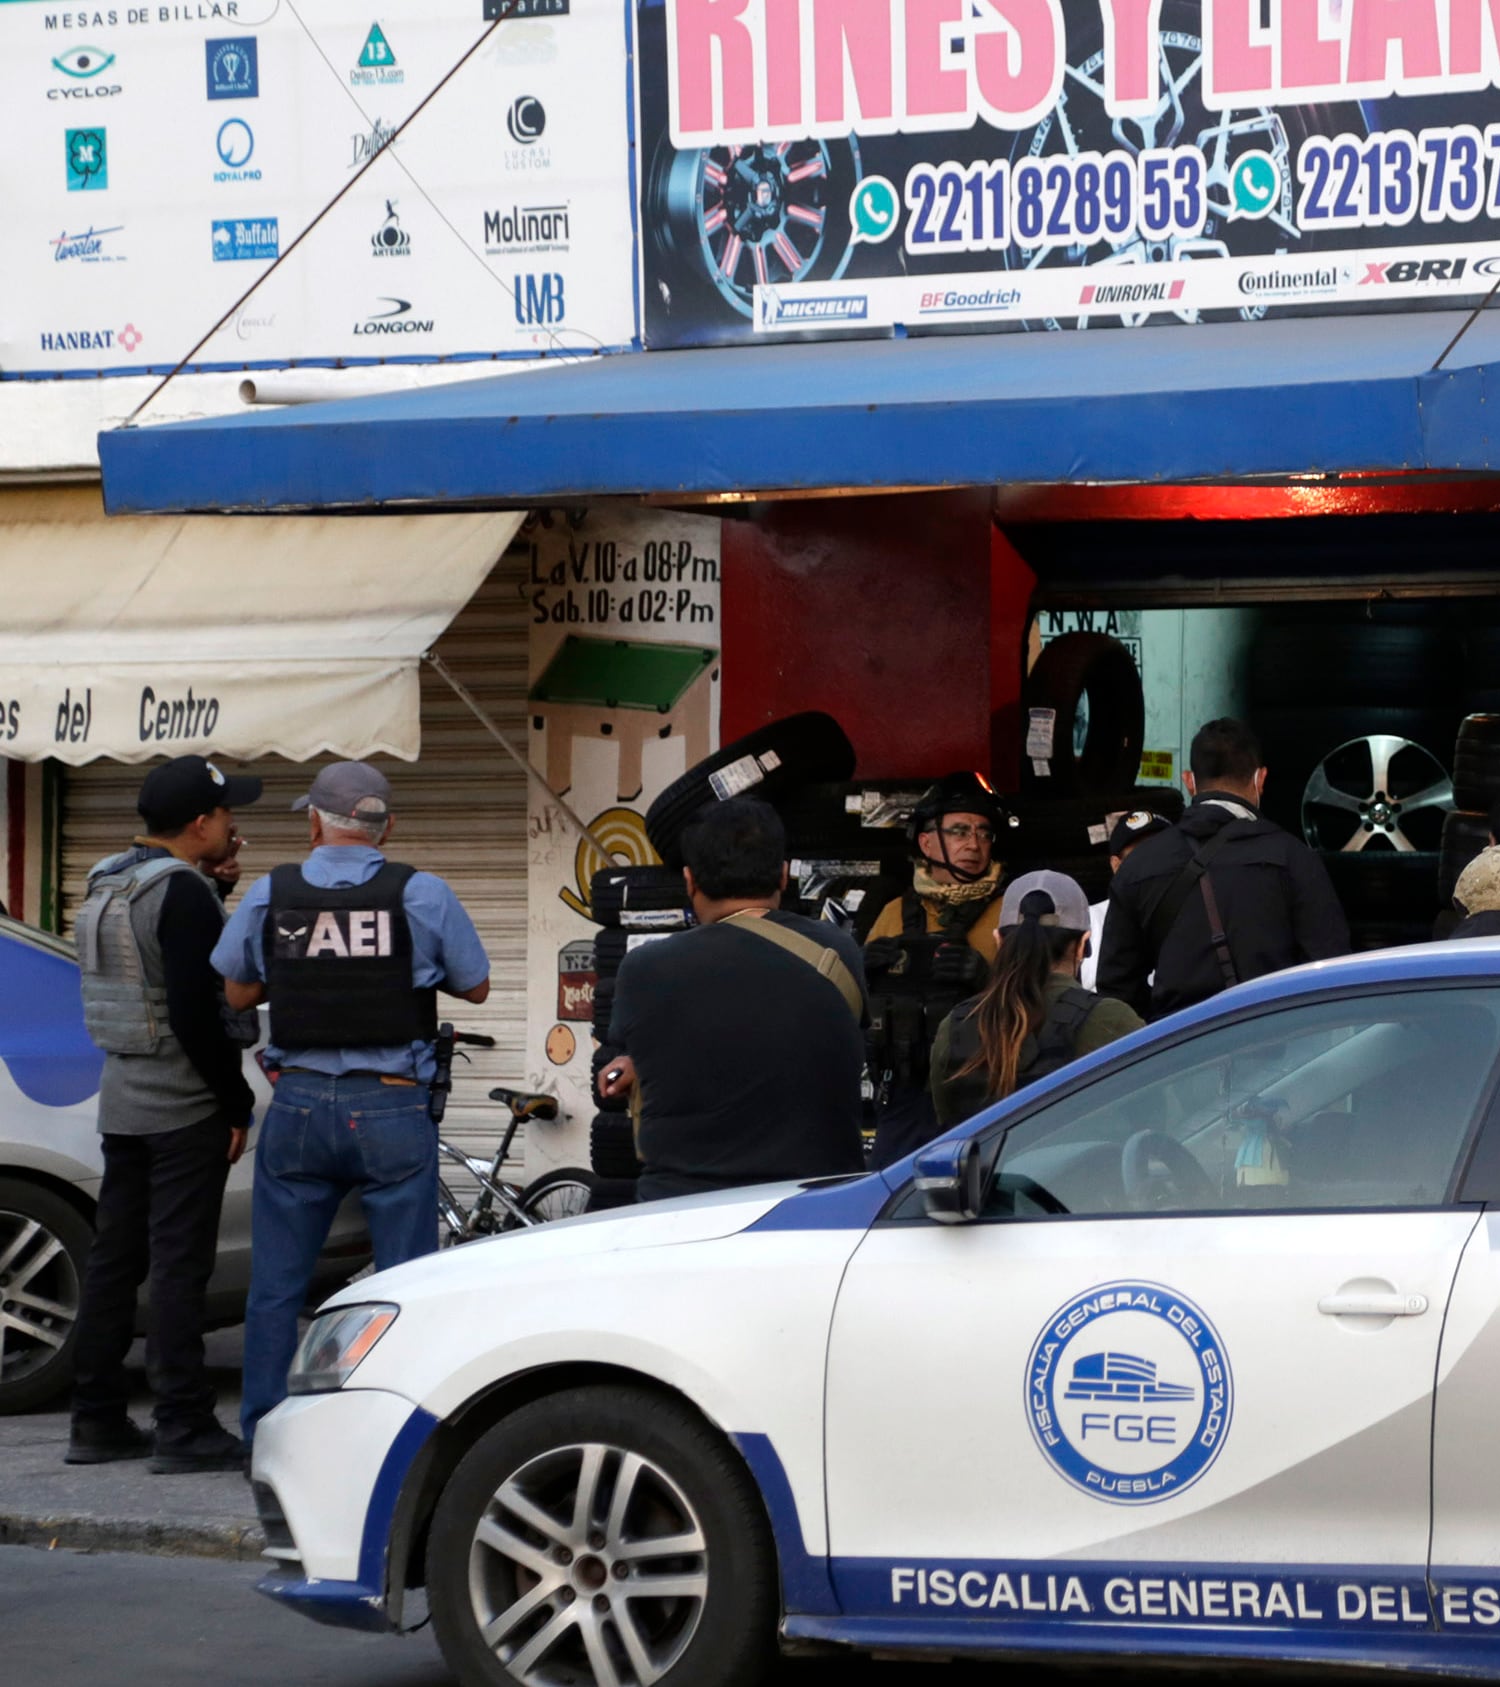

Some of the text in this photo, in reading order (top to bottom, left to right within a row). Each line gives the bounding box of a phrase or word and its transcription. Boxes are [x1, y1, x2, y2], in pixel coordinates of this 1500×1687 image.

[45, 2, 239, 29] MESAS DE BILLAR
[47, 85, 123, 100] CYCLOP
[1303, 139, 1413, 219] 2213
[911, 155, 1201, 243] 2211 8289 53
[484, 205, 570, 244] Molinari
[372, 247, 411, 258] ARTEMIS
[1238, 267, 1337, 295] Continental
[1358, 258, 1467, 284] XBRI
[920, 289, 1021, 308] BFGoodrich
[1095, 283, 1167, 304] UNIROYAL
[781, 298, 865, 318] MICHELIN
[41, 330, 114, 351] HANBAT
[353, 320, 434, 335] LONGONI
[54, 688, 92, 742] del
[138, 686, 220, 742] Centro
[305, 910, 392, 958] AEI
[564, 954, 592, 970] TiZ
[1054, 1291, 1163, 1340] GENERAL
[1166, 1304, 1203, 1347] DEL
[1199, 1348, 1225, 1448] ESTADO
[1080, 1412, 1177, 1445] FGE
[1085, 1470, 1177, 1493] PUEBLA
[890, 1567, 1090, 1614] FISCALIA
[1106, 1578, 1323, 1621] GENERAL
[1335, 1585, 1428, 1624] DEL
